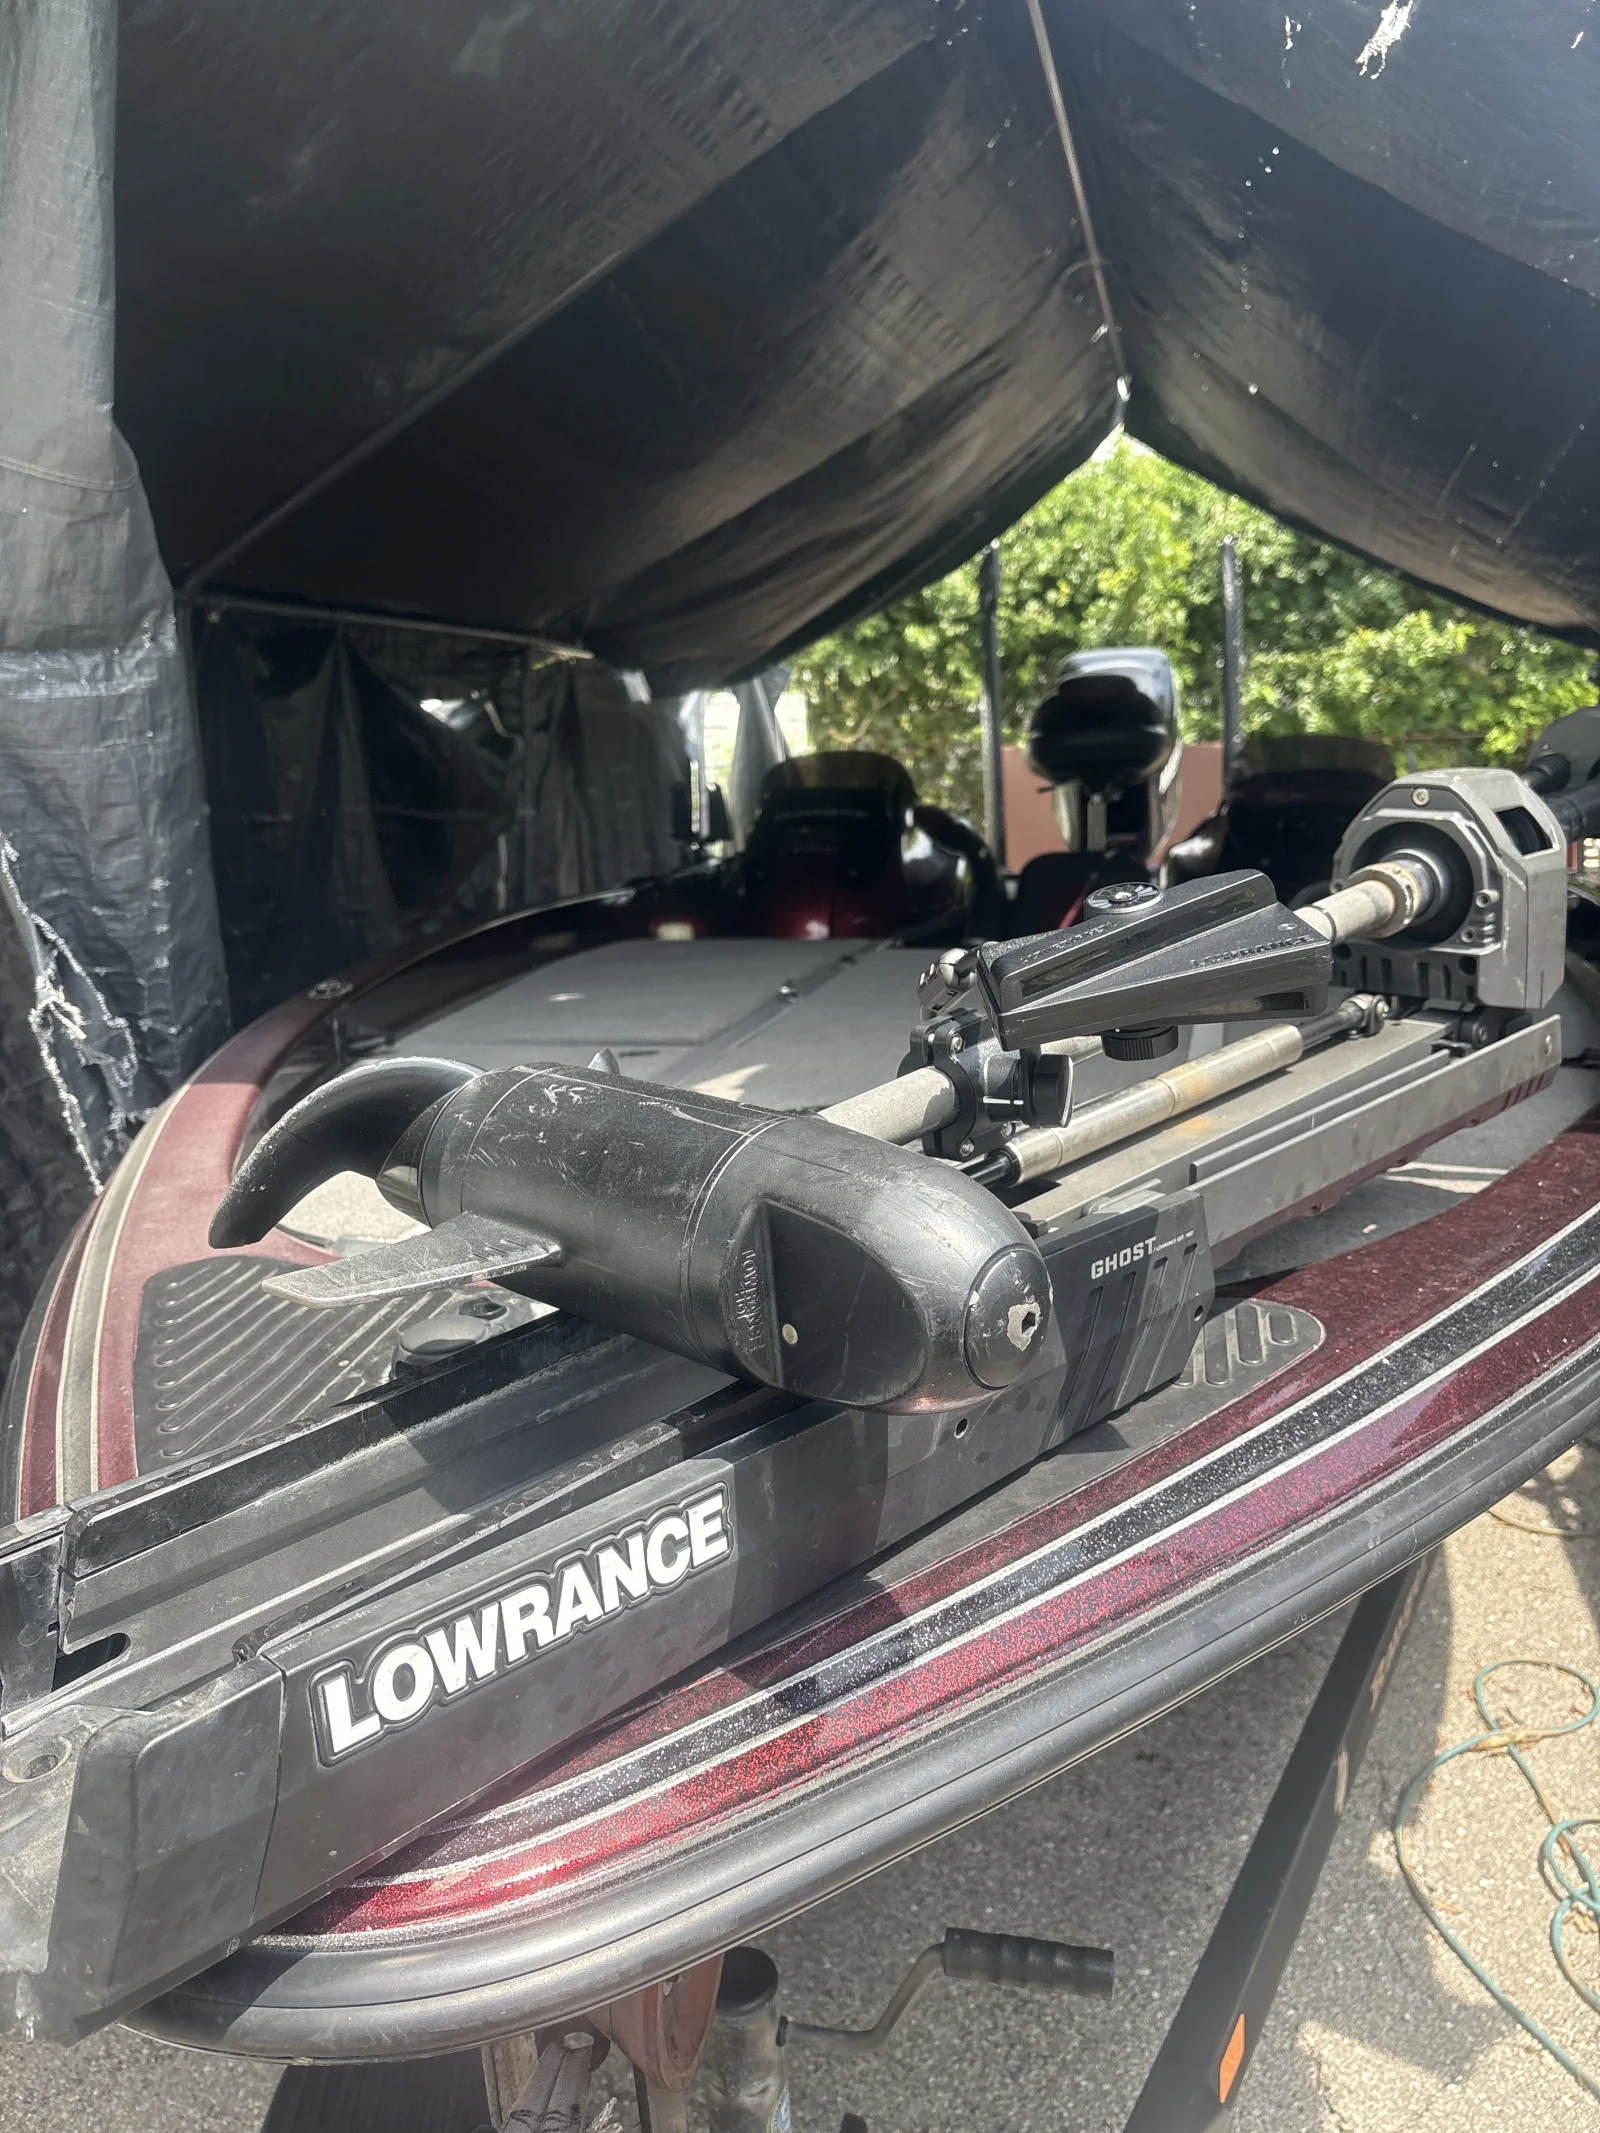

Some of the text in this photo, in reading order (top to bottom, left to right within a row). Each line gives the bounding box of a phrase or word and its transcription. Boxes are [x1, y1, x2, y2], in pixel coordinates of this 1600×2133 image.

[741, 1249, 765, 1351] LOWRANCE
[1091, 1236, 1157, 1280] GHOST
[321, 1493, 729, 1754] LOWRANCE
